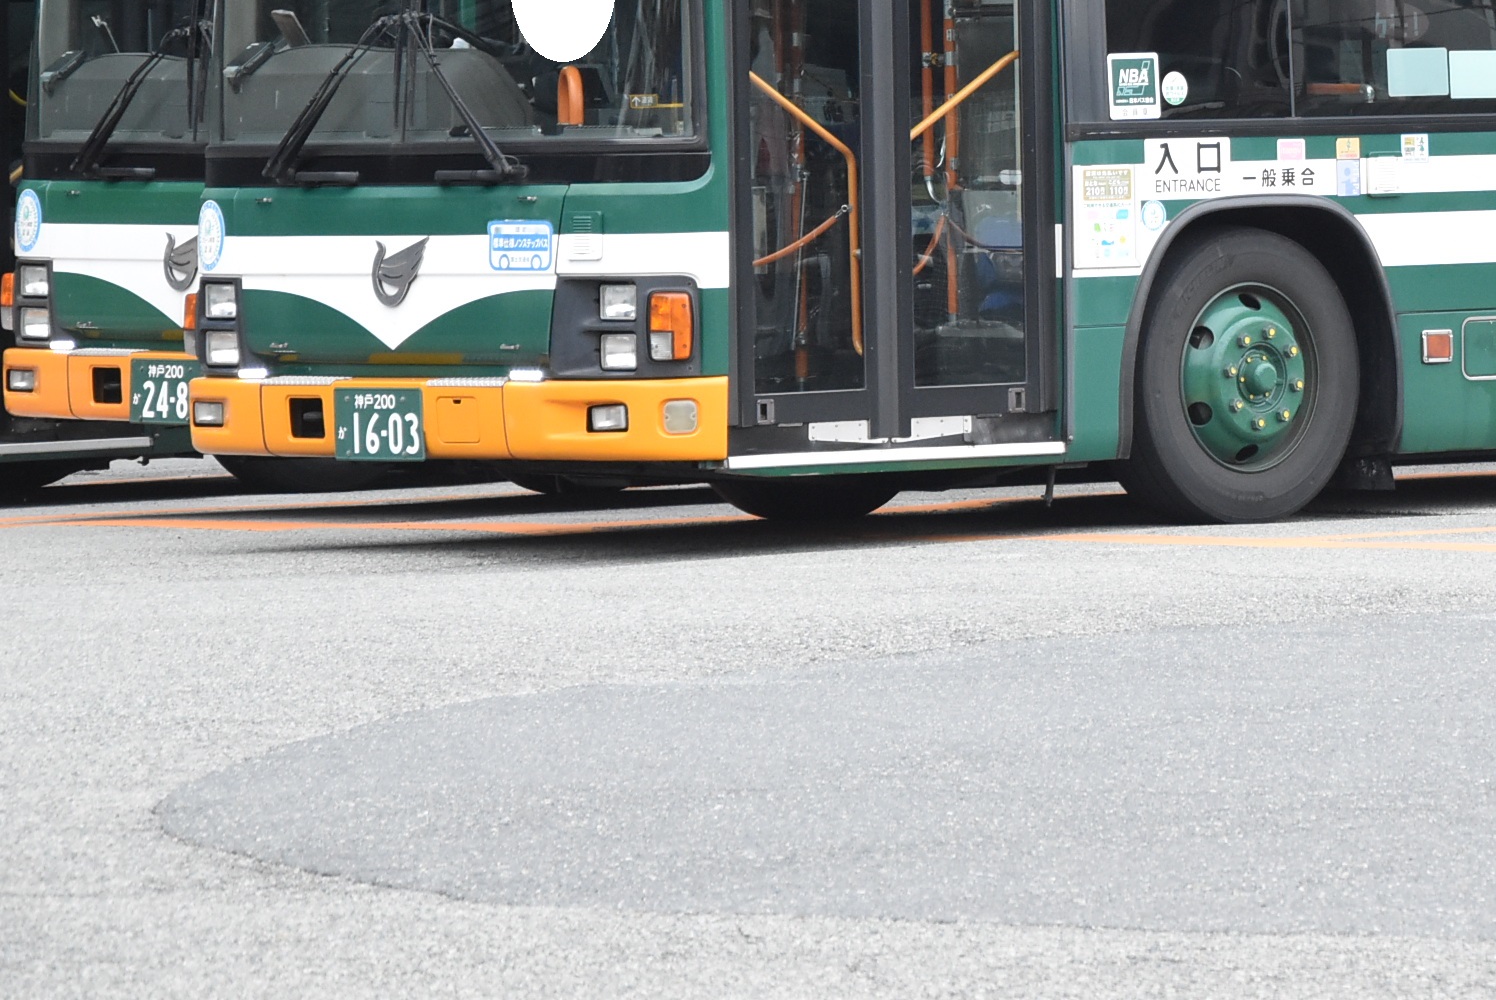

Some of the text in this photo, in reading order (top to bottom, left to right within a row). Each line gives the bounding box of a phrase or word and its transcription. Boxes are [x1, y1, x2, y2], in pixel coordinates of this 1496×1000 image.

[1119, 68, 1149, 84] NBA
[1154, 141, 1221, 175] 入口
[1155, 178, 1221, 193] ENTRANCE
[1242, 167, 1315, 188] 一般乗合
[142, 380, 188, 419] 24-8
[353, 412, 420, 455] 16-03
